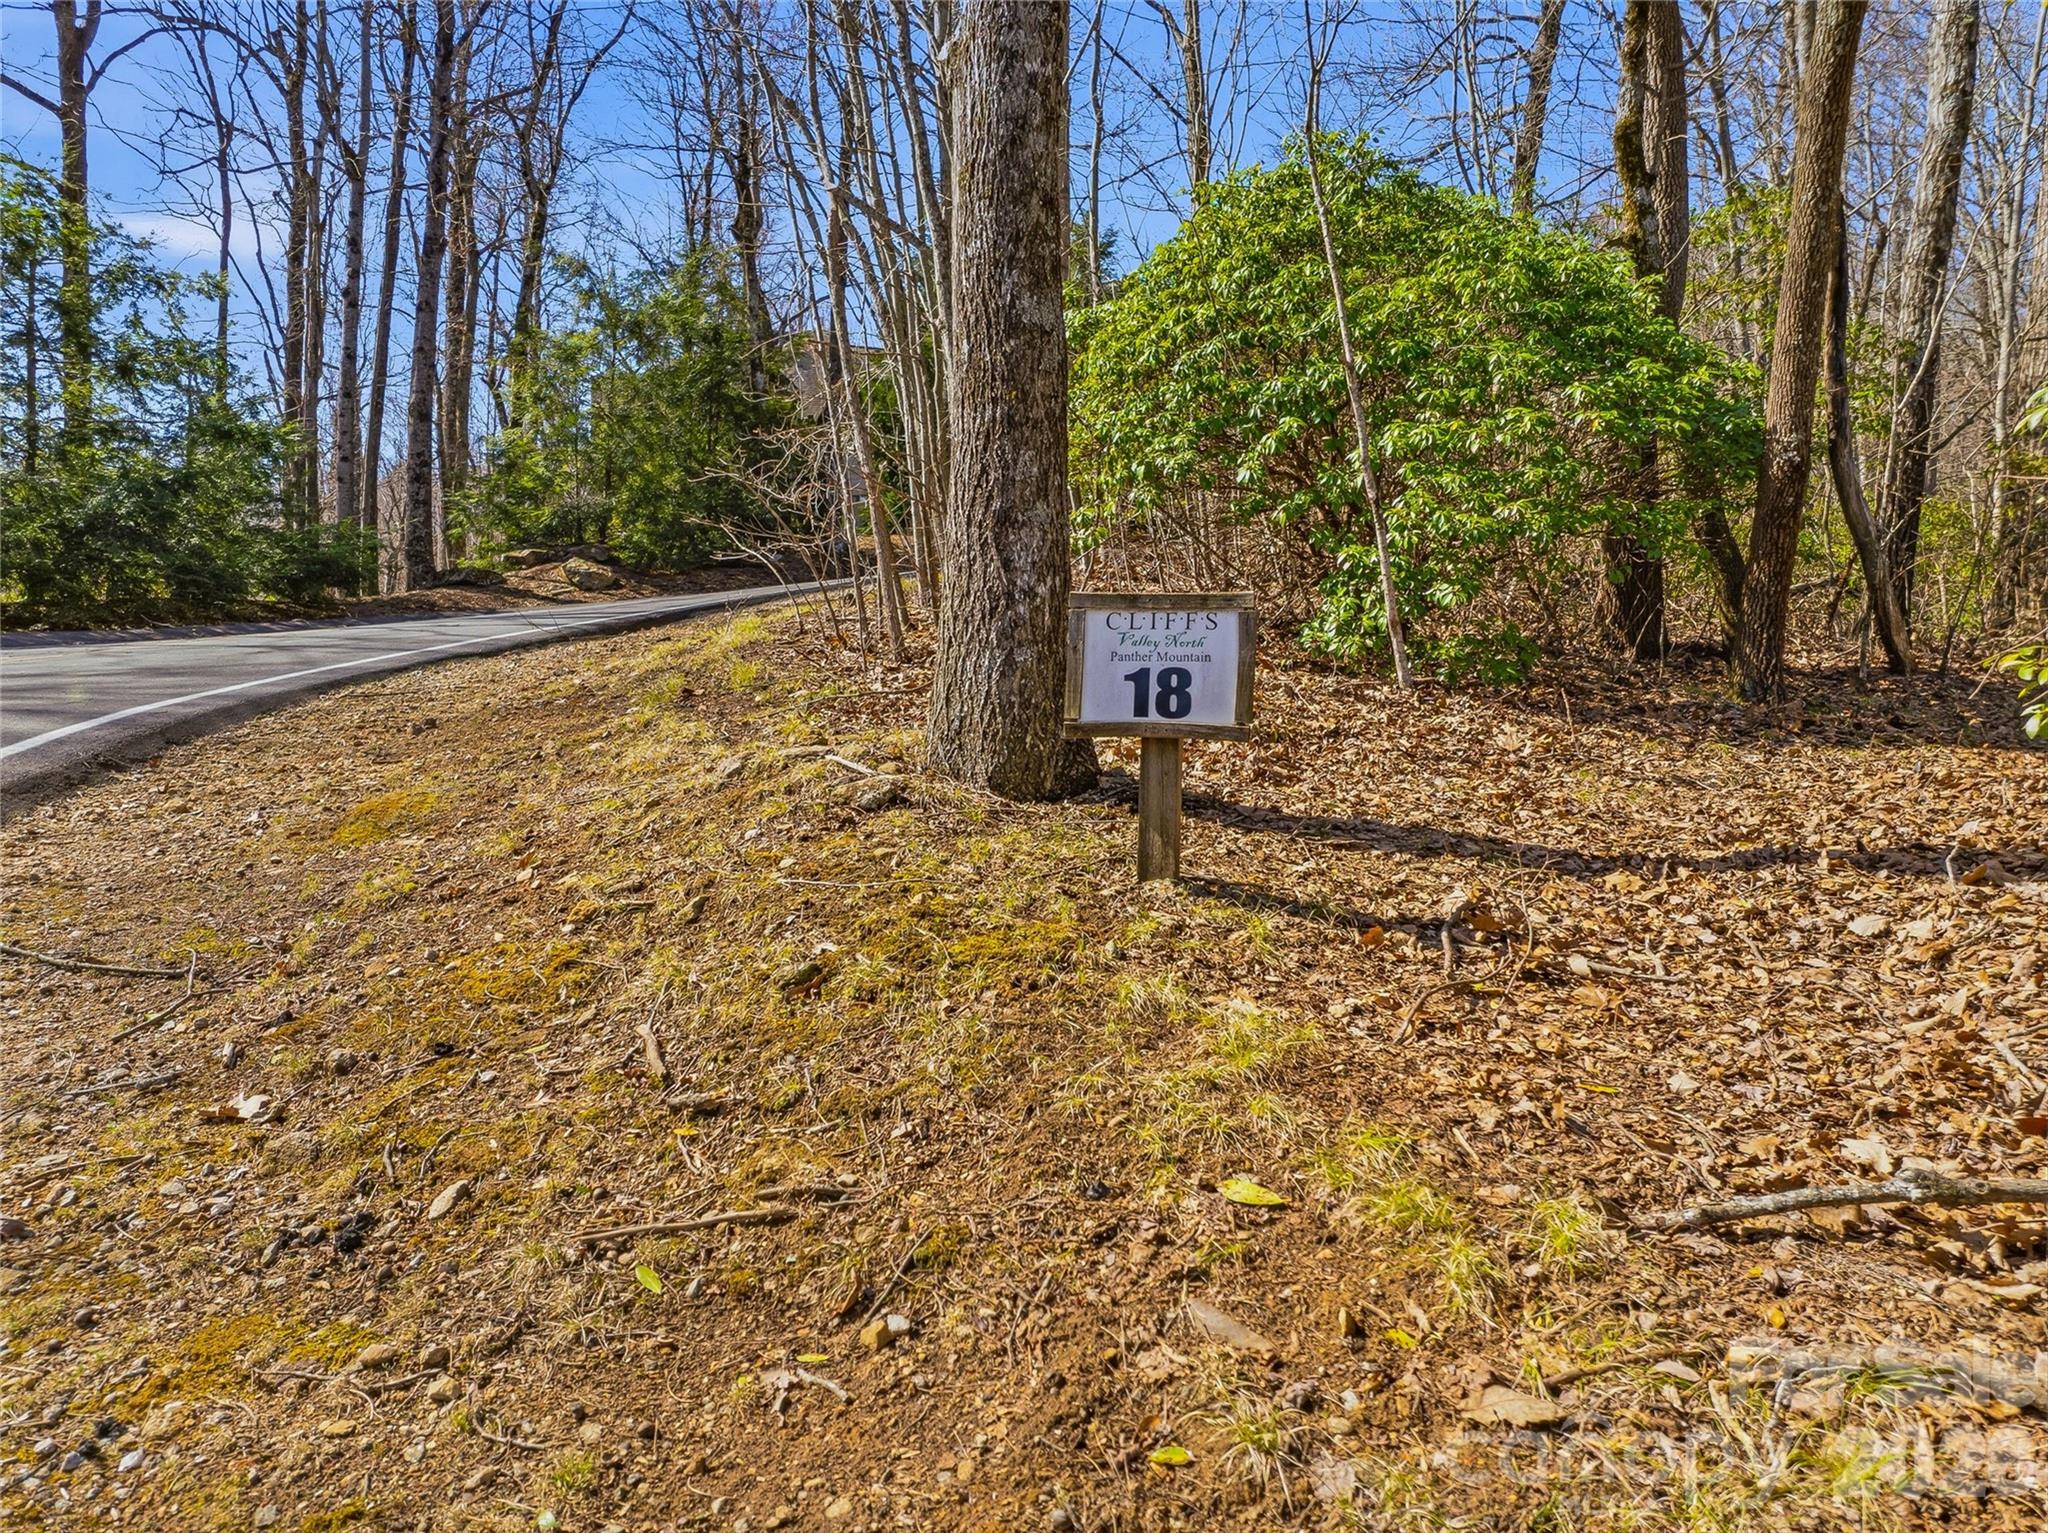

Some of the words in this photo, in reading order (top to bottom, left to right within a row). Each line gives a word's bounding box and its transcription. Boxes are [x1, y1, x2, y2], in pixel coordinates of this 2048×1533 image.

[1117, 631, 1161, 653] Valley
[1164, 631, 1208, 648] North
[1110, 651, 1153, 663] Panther
[1156, 651, 1212, 663] Mountain
[1123, 666, 1193, 719] 18
